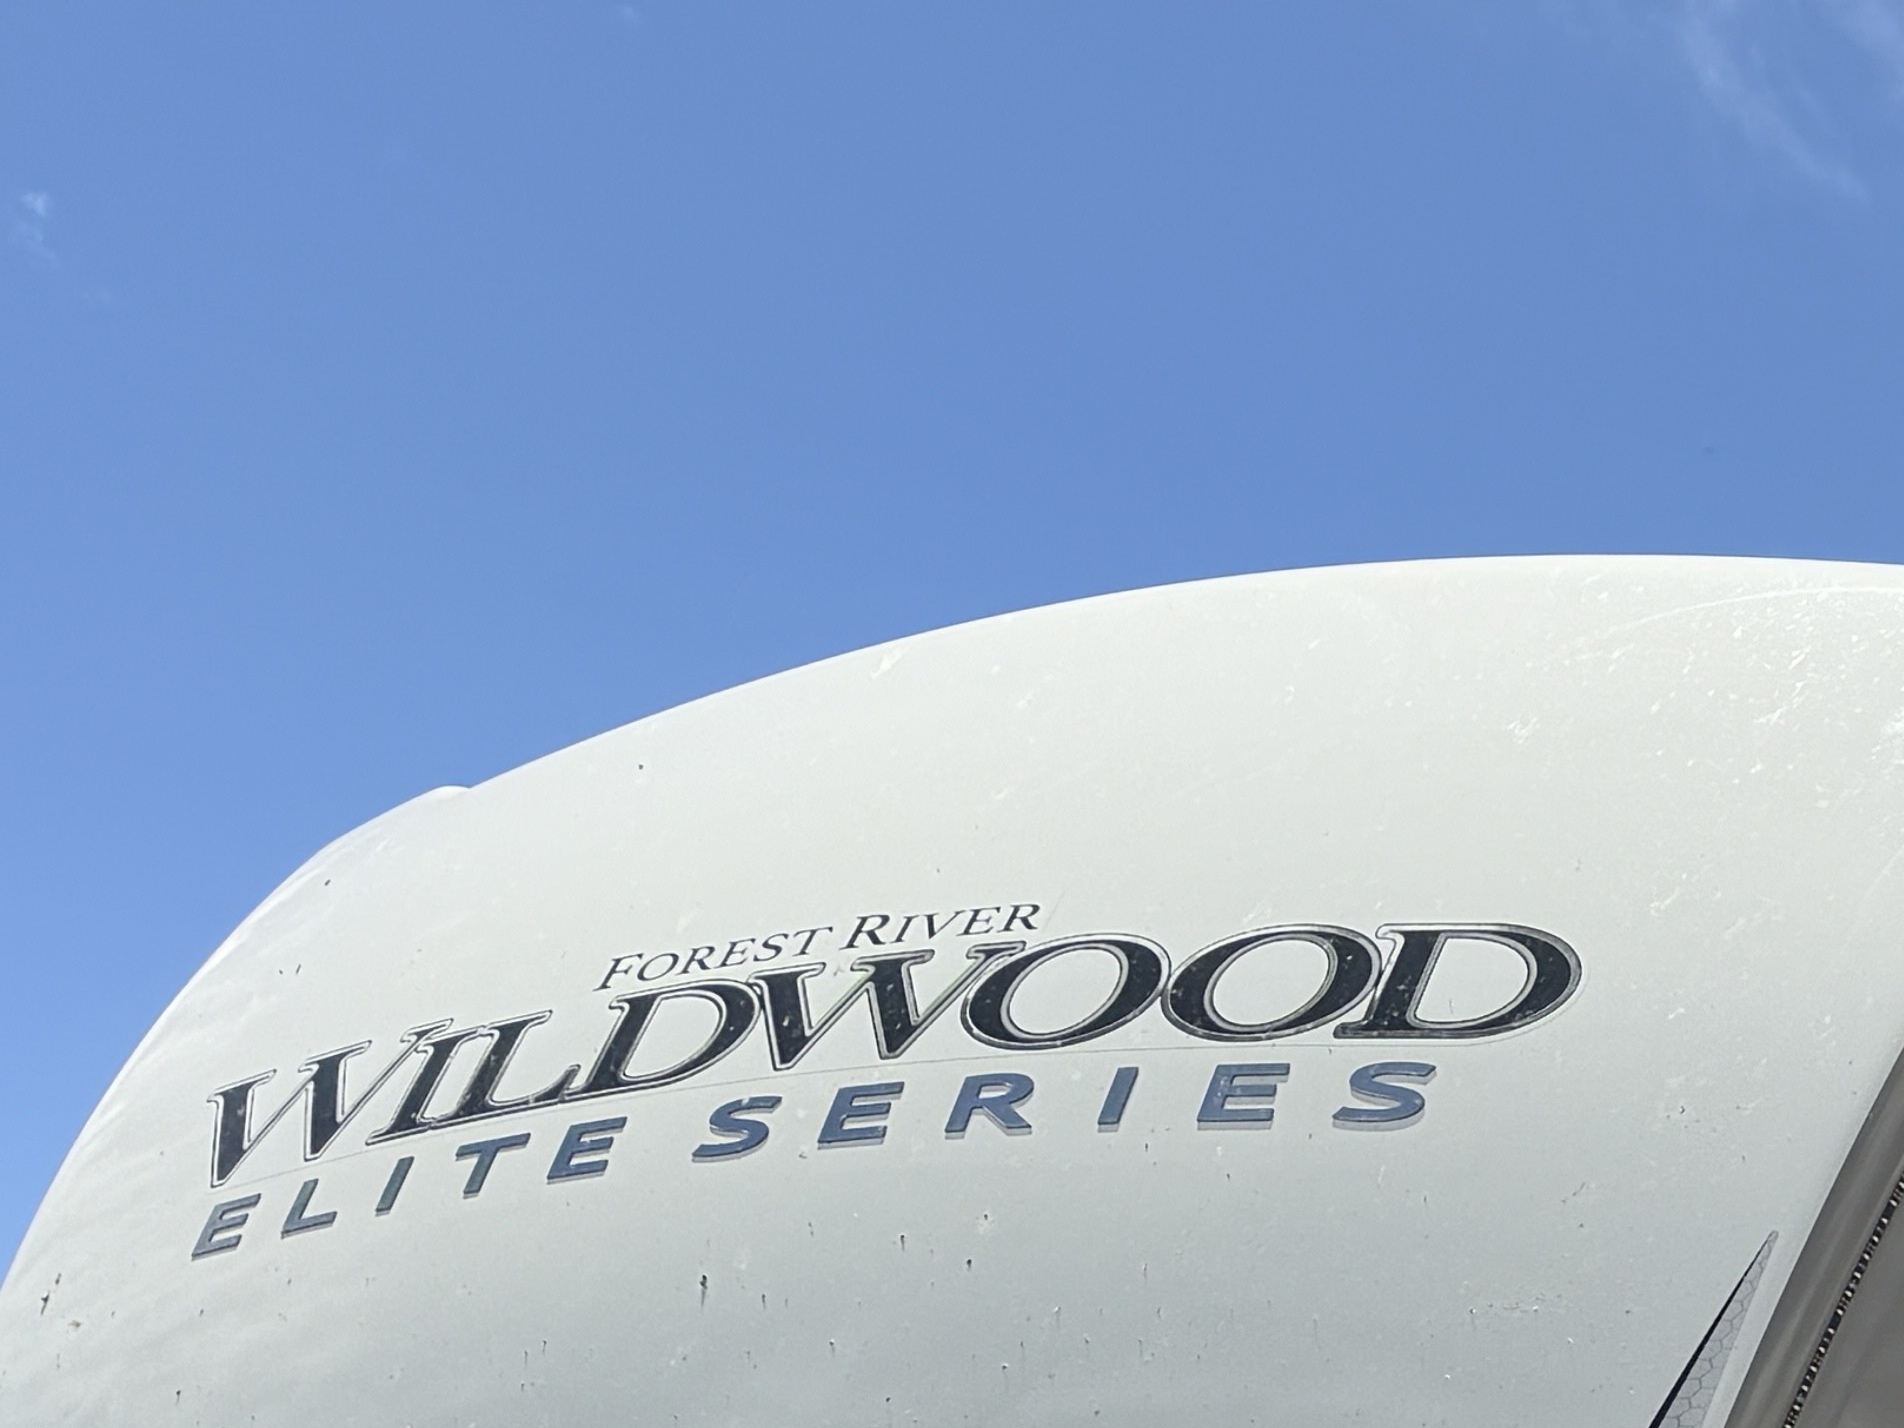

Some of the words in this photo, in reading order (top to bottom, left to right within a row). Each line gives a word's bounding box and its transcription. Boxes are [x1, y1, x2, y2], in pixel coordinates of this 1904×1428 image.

[599, 925, 832, 991] FOREST
[842, 902, 1042, 957] RIVER
[209, 920, 1586, 1190] WILDWOOD
[191, 1114, 628, 1261] ELITE
[691, 1058, 1438, 1165] SERIES
